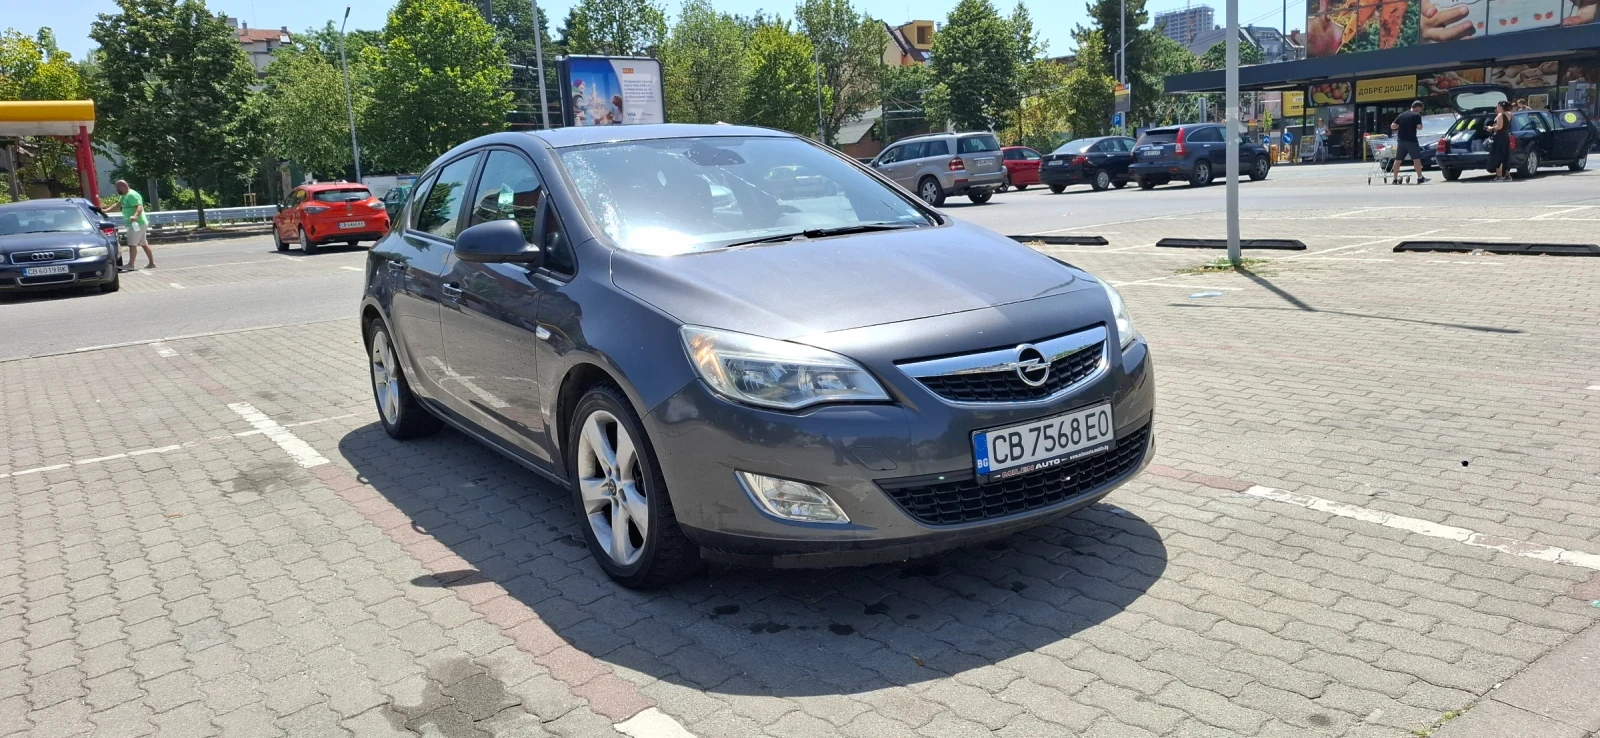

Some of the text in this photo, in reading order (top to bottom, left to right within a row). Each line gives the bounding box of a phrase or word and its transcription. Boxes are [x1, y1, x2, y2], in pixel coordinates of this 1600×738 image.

[1358, 83, 1414, 96] ДОБРЕ ДОШЛИ
[1114, 116, 1120, 124] P
[27, 267, 38, 276] CB
[57, 265, 67, 273] BK
[992, 410, 1109, 464] CB 7568 EO
[977, 458, 989, 469] BG
[1001, 464, 1034, 478] MILEN
[1035, 458, 1061, 470] AUTO
